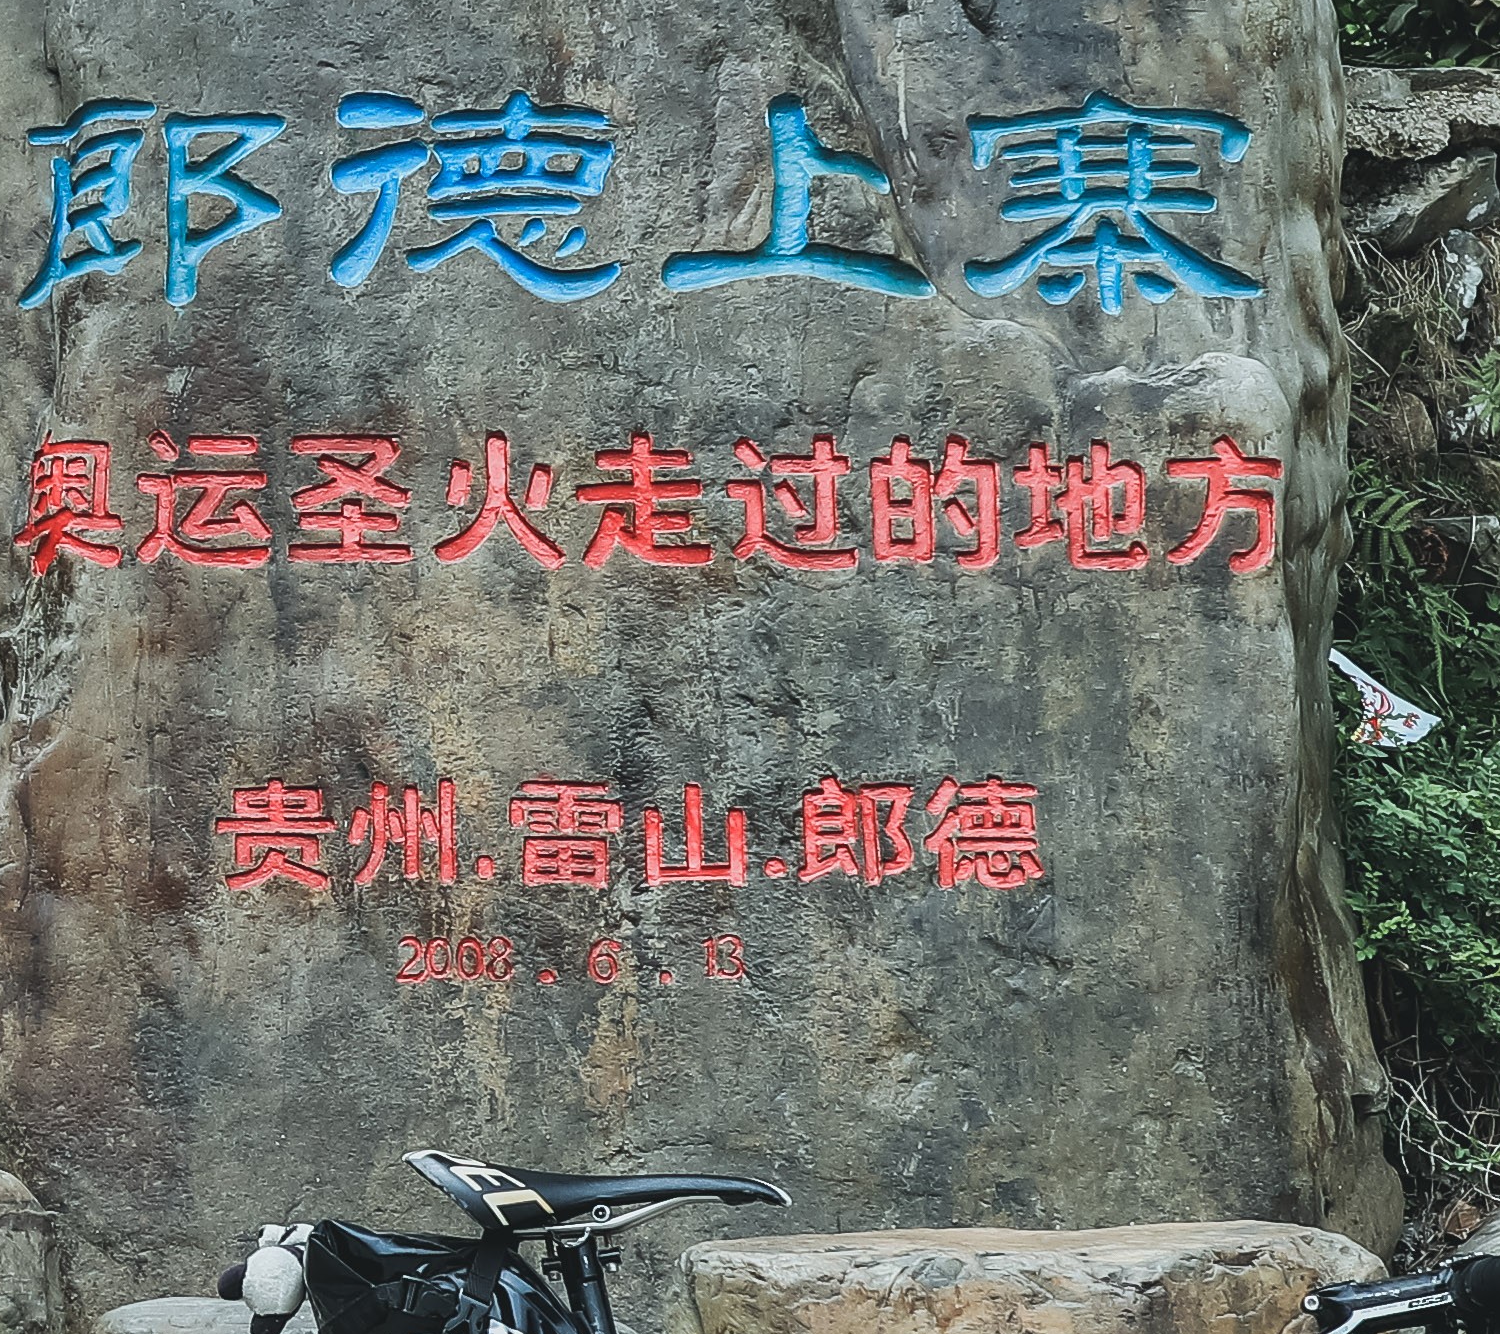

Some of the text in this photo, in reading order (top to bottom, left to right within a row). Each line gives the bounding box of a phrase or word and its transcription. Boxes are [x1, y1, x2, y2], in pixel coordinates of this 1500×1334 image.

[16, 89, 1266, 314] 郎德上寨
[11, 427, 1284, 578] 奥运圣火走过的地方
